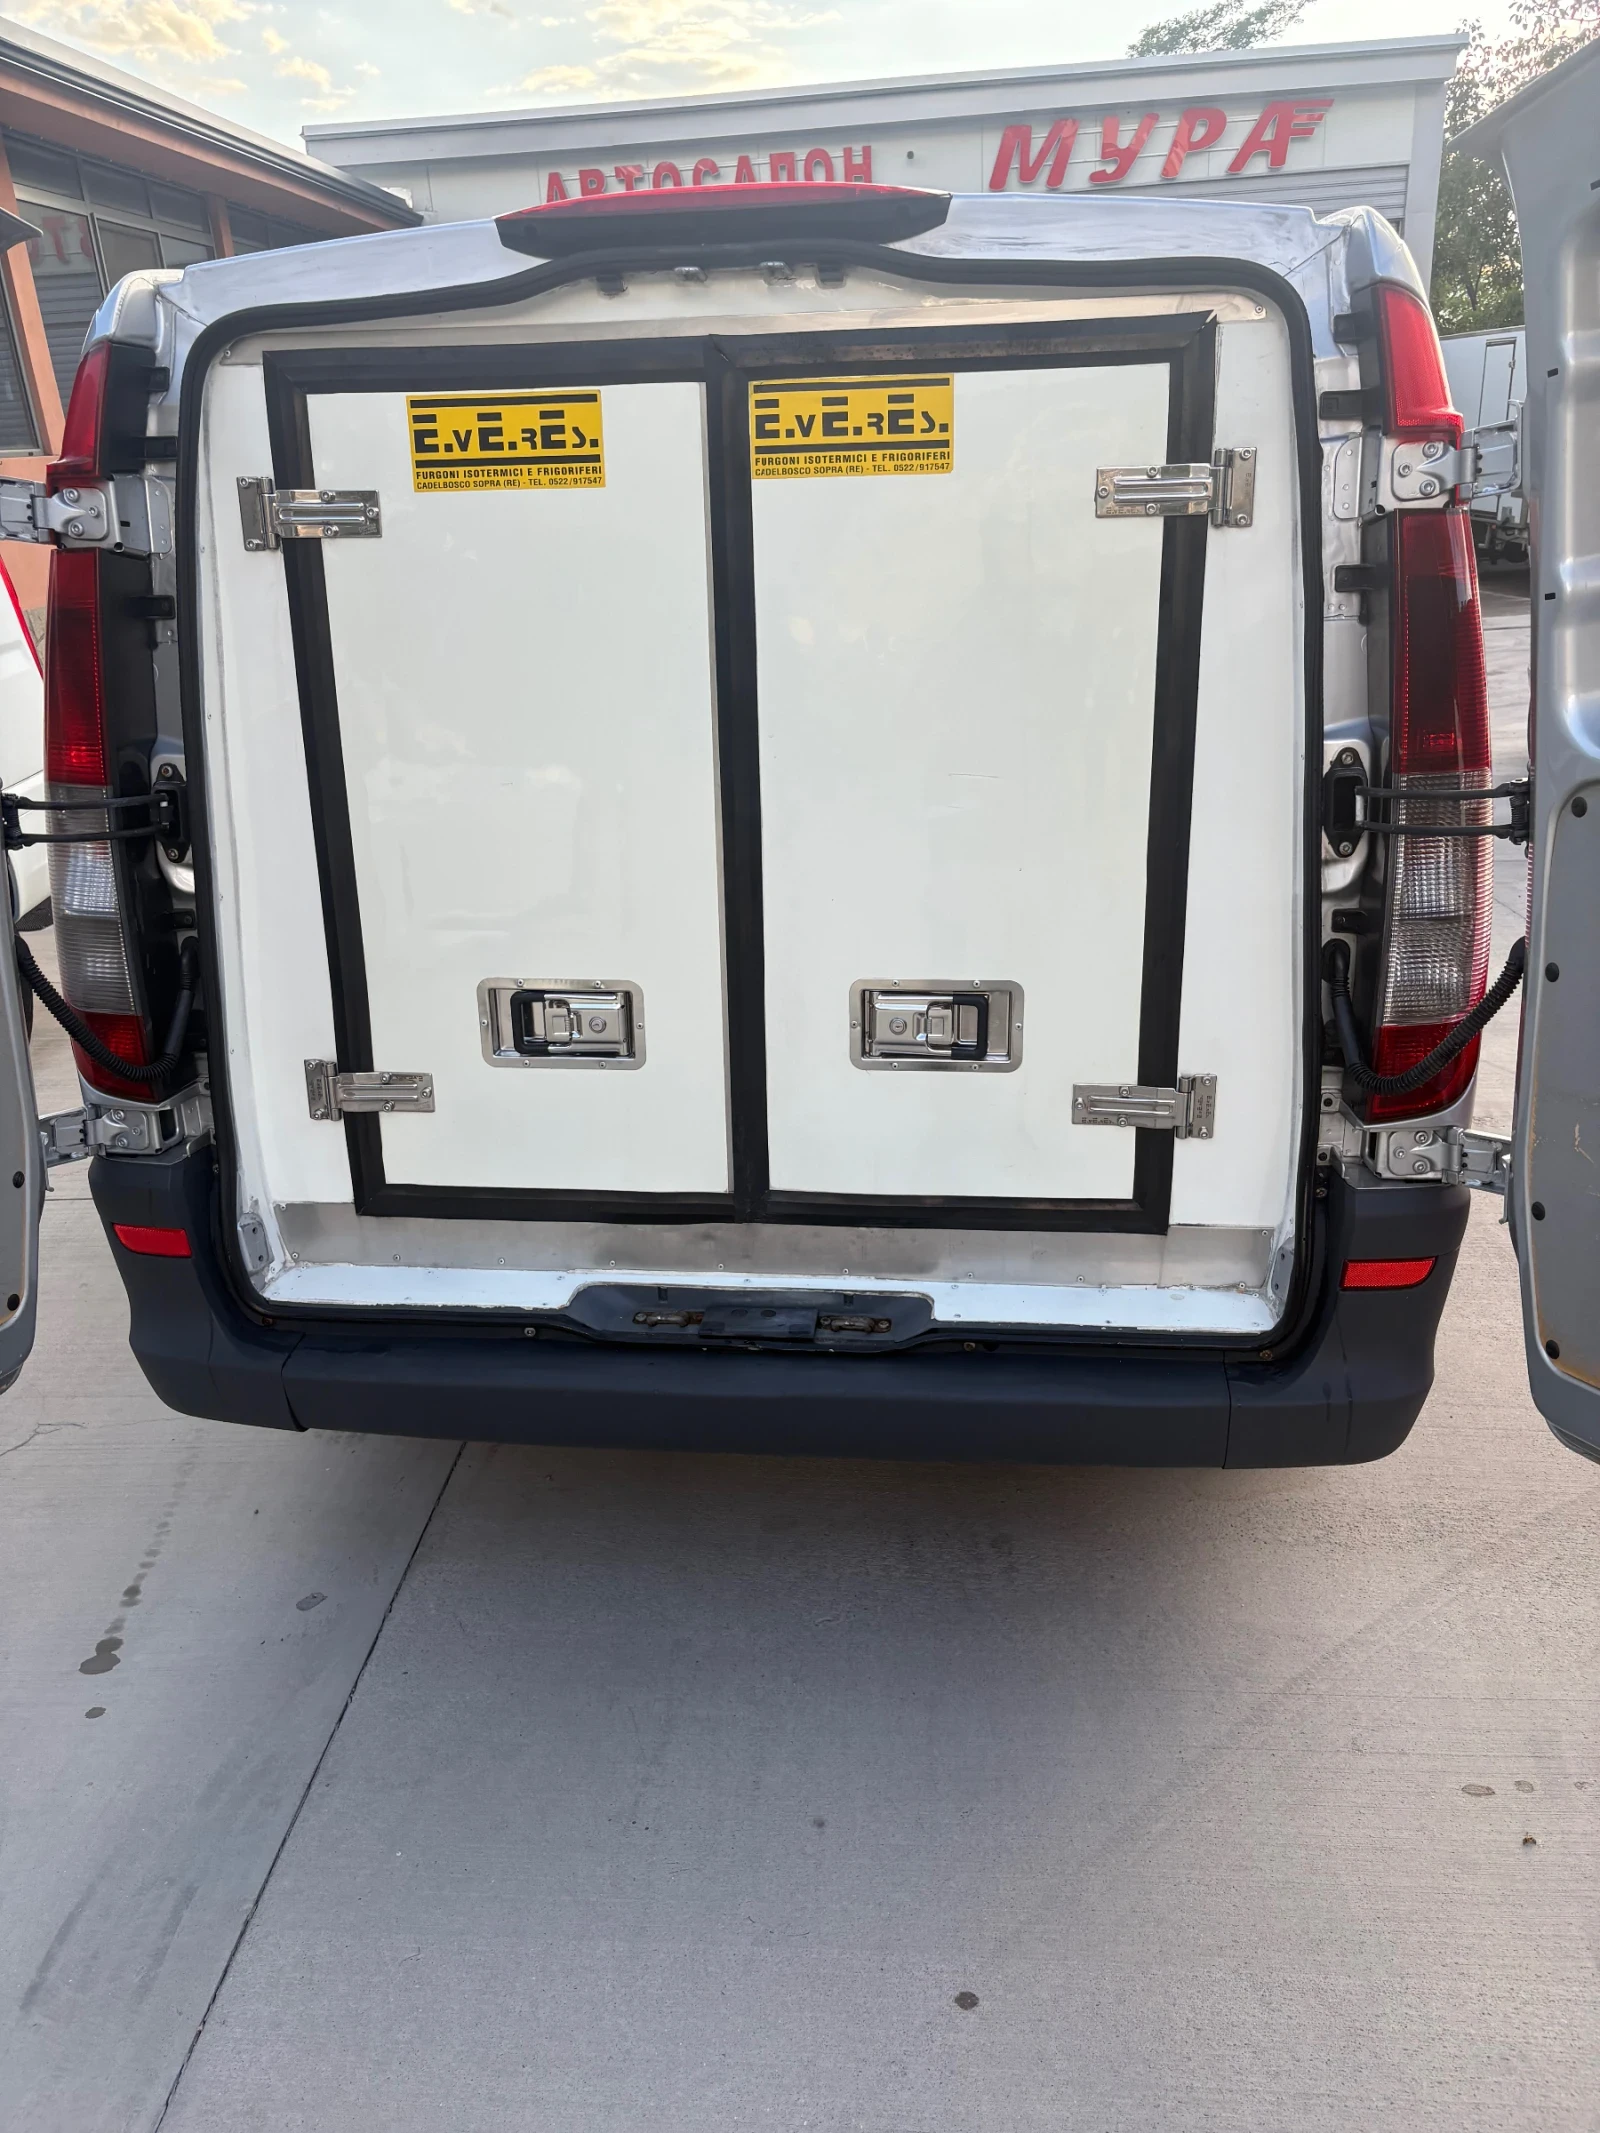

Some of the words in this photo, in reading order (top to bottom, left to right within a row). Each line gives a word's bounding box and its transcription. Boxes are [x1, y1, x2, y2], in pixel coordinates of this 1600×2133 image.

[755, 456, 800, 466] FURGONI
[804, 453, 867, 465] ISOTERMICI
[872, 453, 878, 462] E
[882, 451, 950, 462] FRIGORIFERI
[416, 469, 459, 480] FURGONI
[463, 467, 523, 479] ISOTERMICI
[527, 467, 533, 476] E
[537, 465, 602, 476] FRIGORIFERI
[755, 466, 811, 476] CADELBOSCO
[813, 465, 843, 474] SOPRA
[845, 464, 864, 475] (RE)
[872, 464, 890, 473] TEL.
[893, 462, 950, 472] 0522/917547
[416, 480, 471, 490] CADELBOSCO
[473, 479, 501, 488] SOPRA
[503, 478, 521, 489] (RE)
[529, 478, 546, 487] TEL.
[549, 476, 602, 486] 0522/917547
